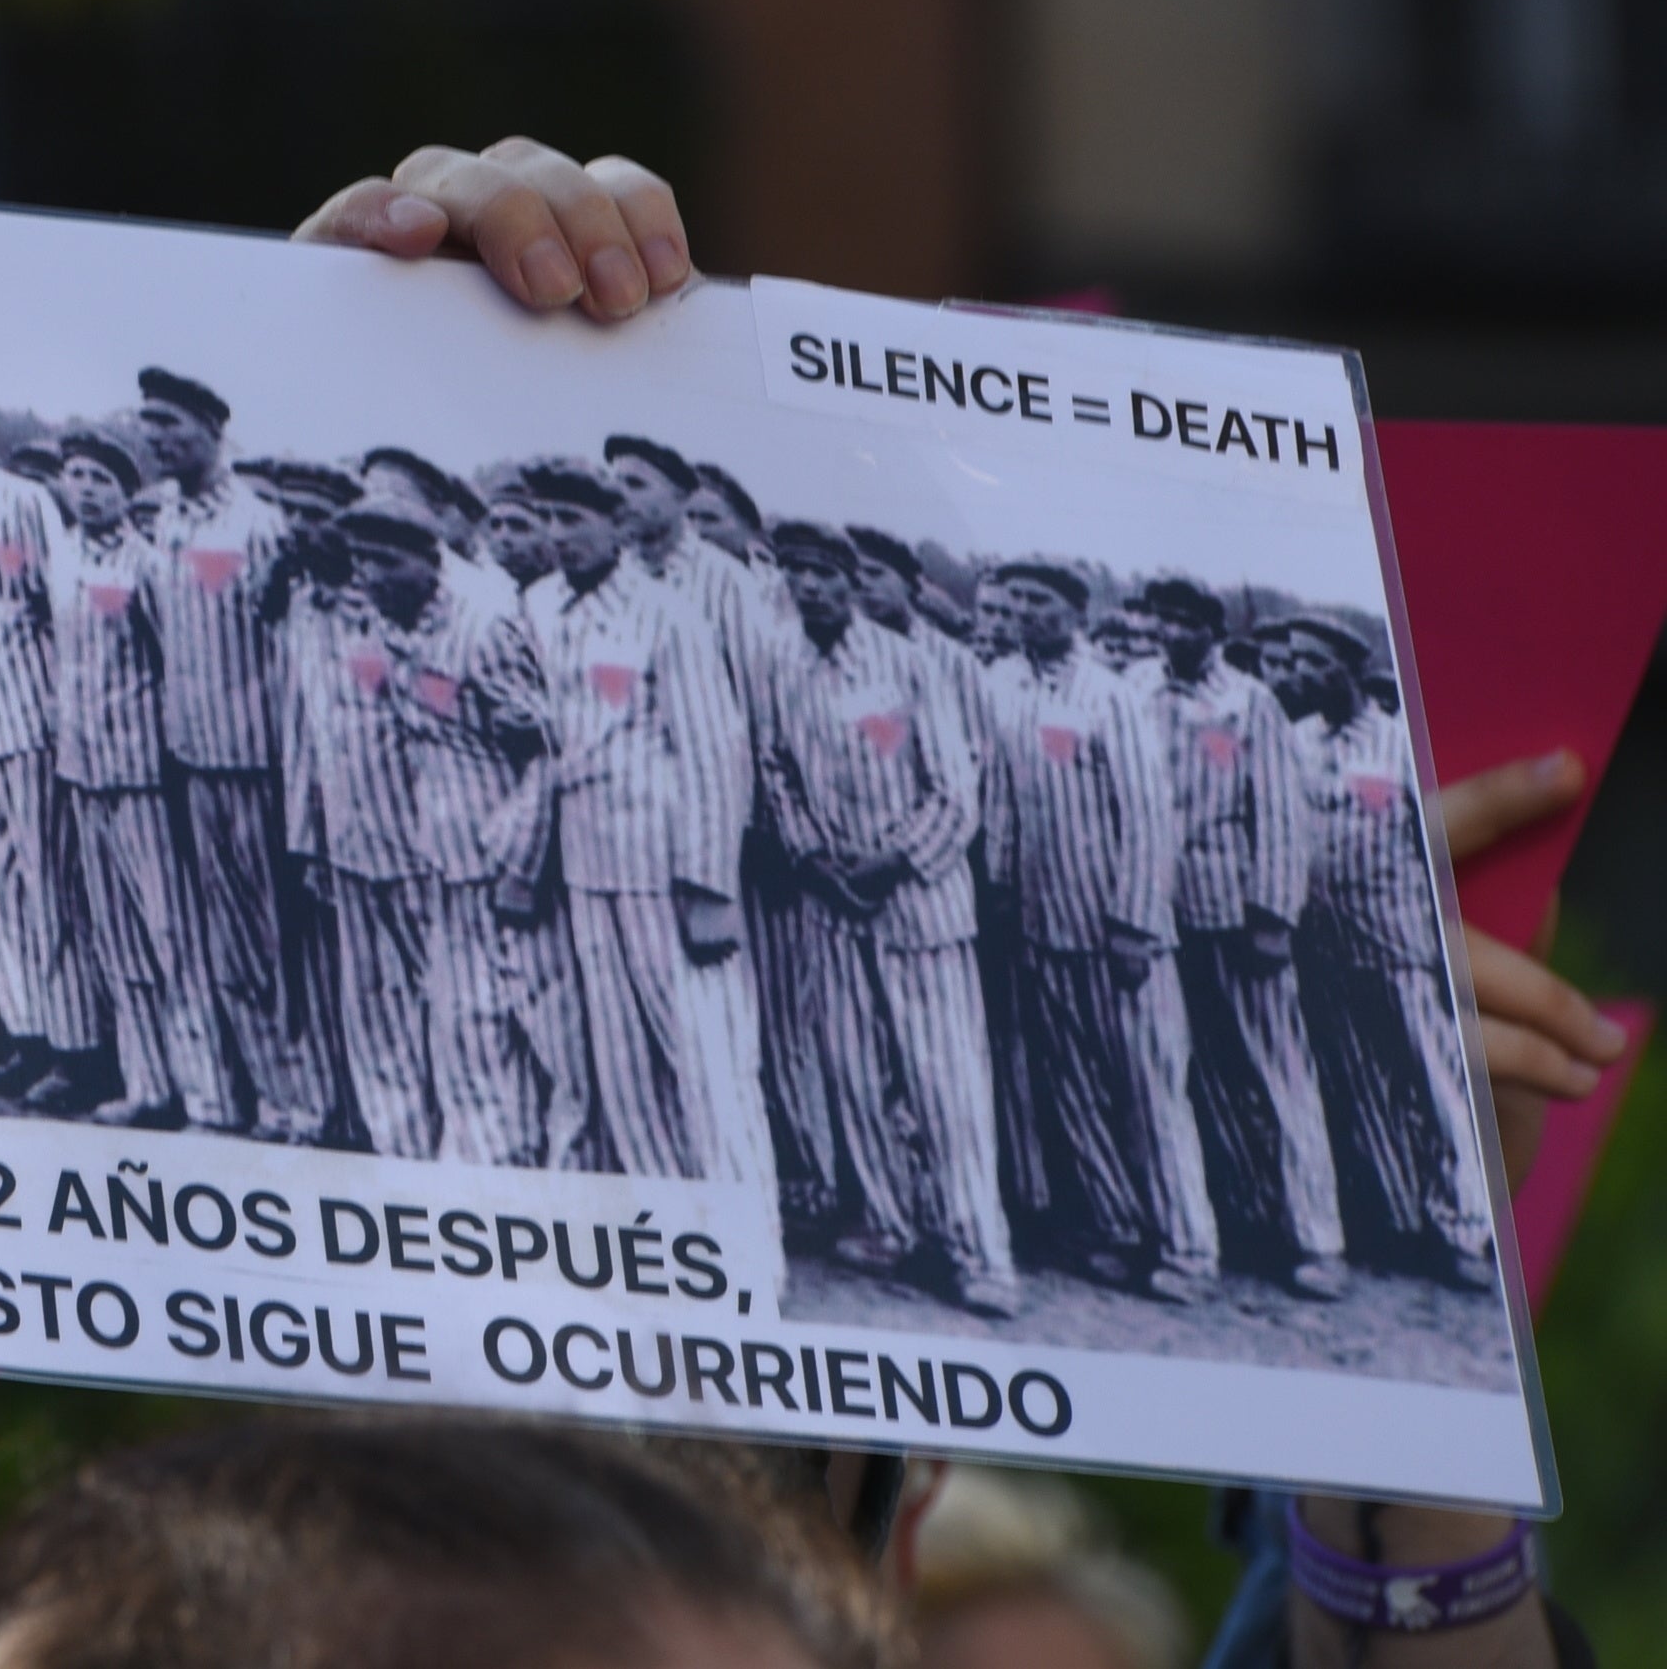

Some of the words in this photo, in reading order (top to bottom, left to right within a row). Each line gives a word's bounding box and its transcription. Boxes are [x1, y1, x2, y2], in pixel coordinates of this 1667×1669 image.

[788, 332, 1054, 424] SILENCE
[1129, 389, 1341, 472] DEATH
[46, 1159, 298, 1259] AÑOS
[318, 1197, 753, 1316] DESPUÉS,
[164, 1289, 432, 1383] SIGUE
[482, 1316, 1074, 1439] OCURRIENDO
